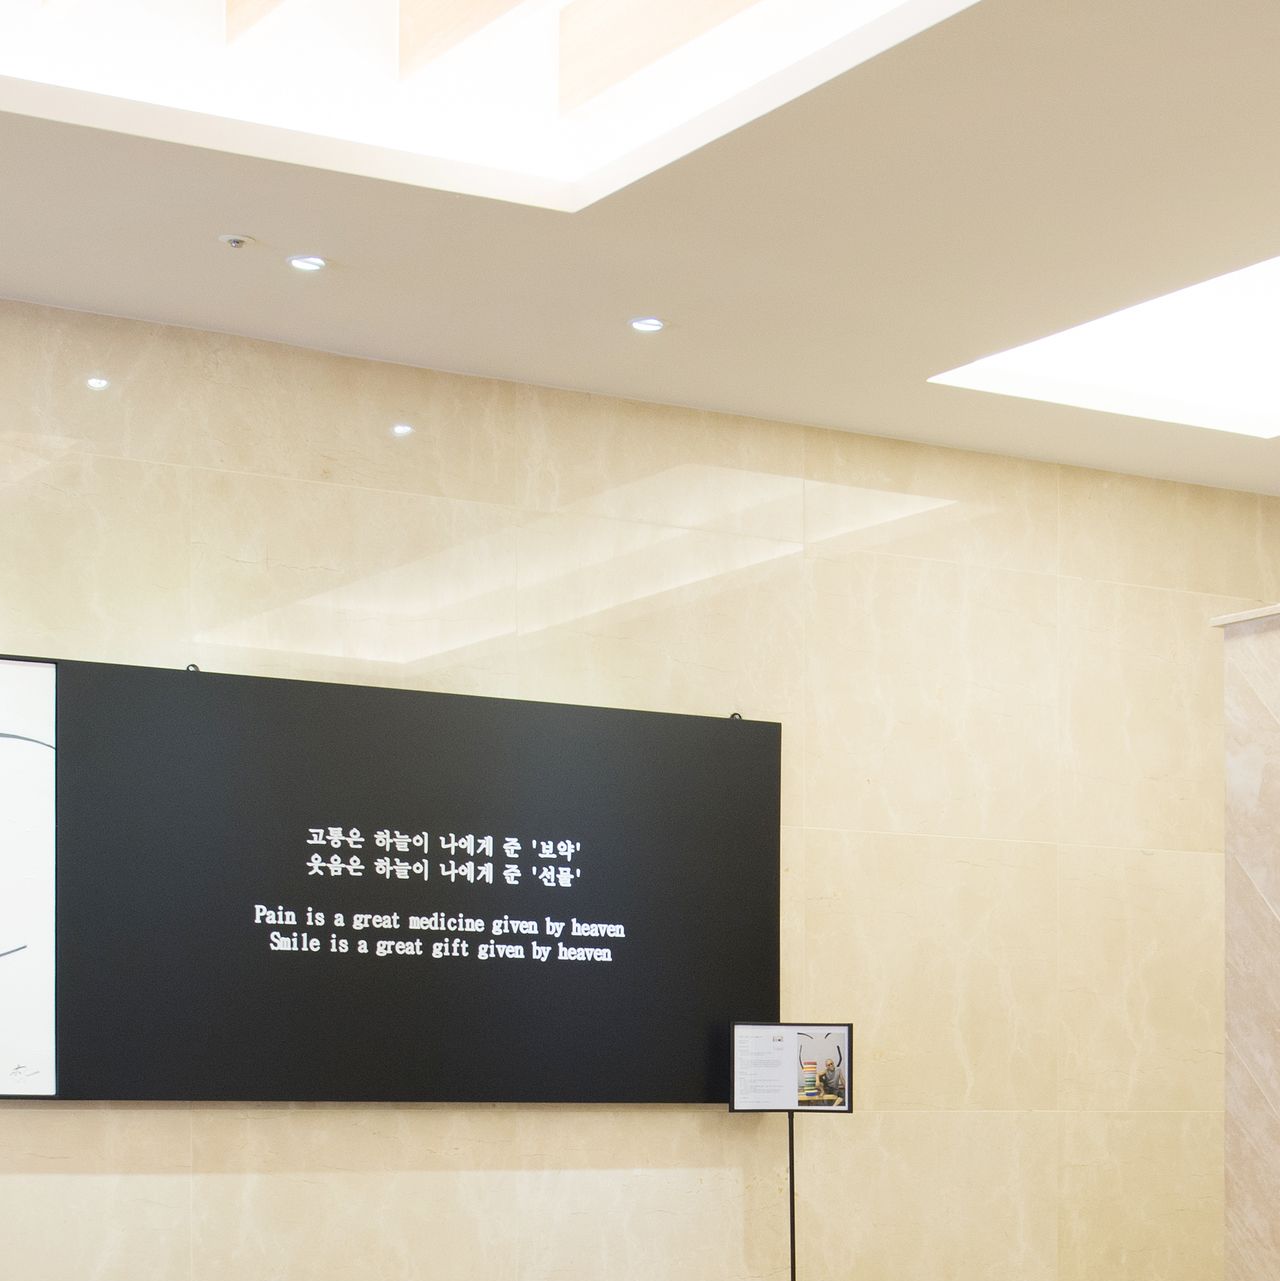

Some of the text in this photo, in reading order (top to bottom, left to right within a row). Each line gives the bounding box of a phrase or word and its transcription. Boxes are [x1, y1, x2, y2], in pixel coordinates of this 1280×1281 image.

[305, 826, 581, 863] 고통은 하늘이 나에게 준 '보약'
[305, 852, 581, 888] 웃음은 하늘이 나에게 준 '선물'
[254, 904, 626, 939] Pain is a great medicine given by heaven
[269, 931, 613, 963] Smile is a great gift given by heaven
